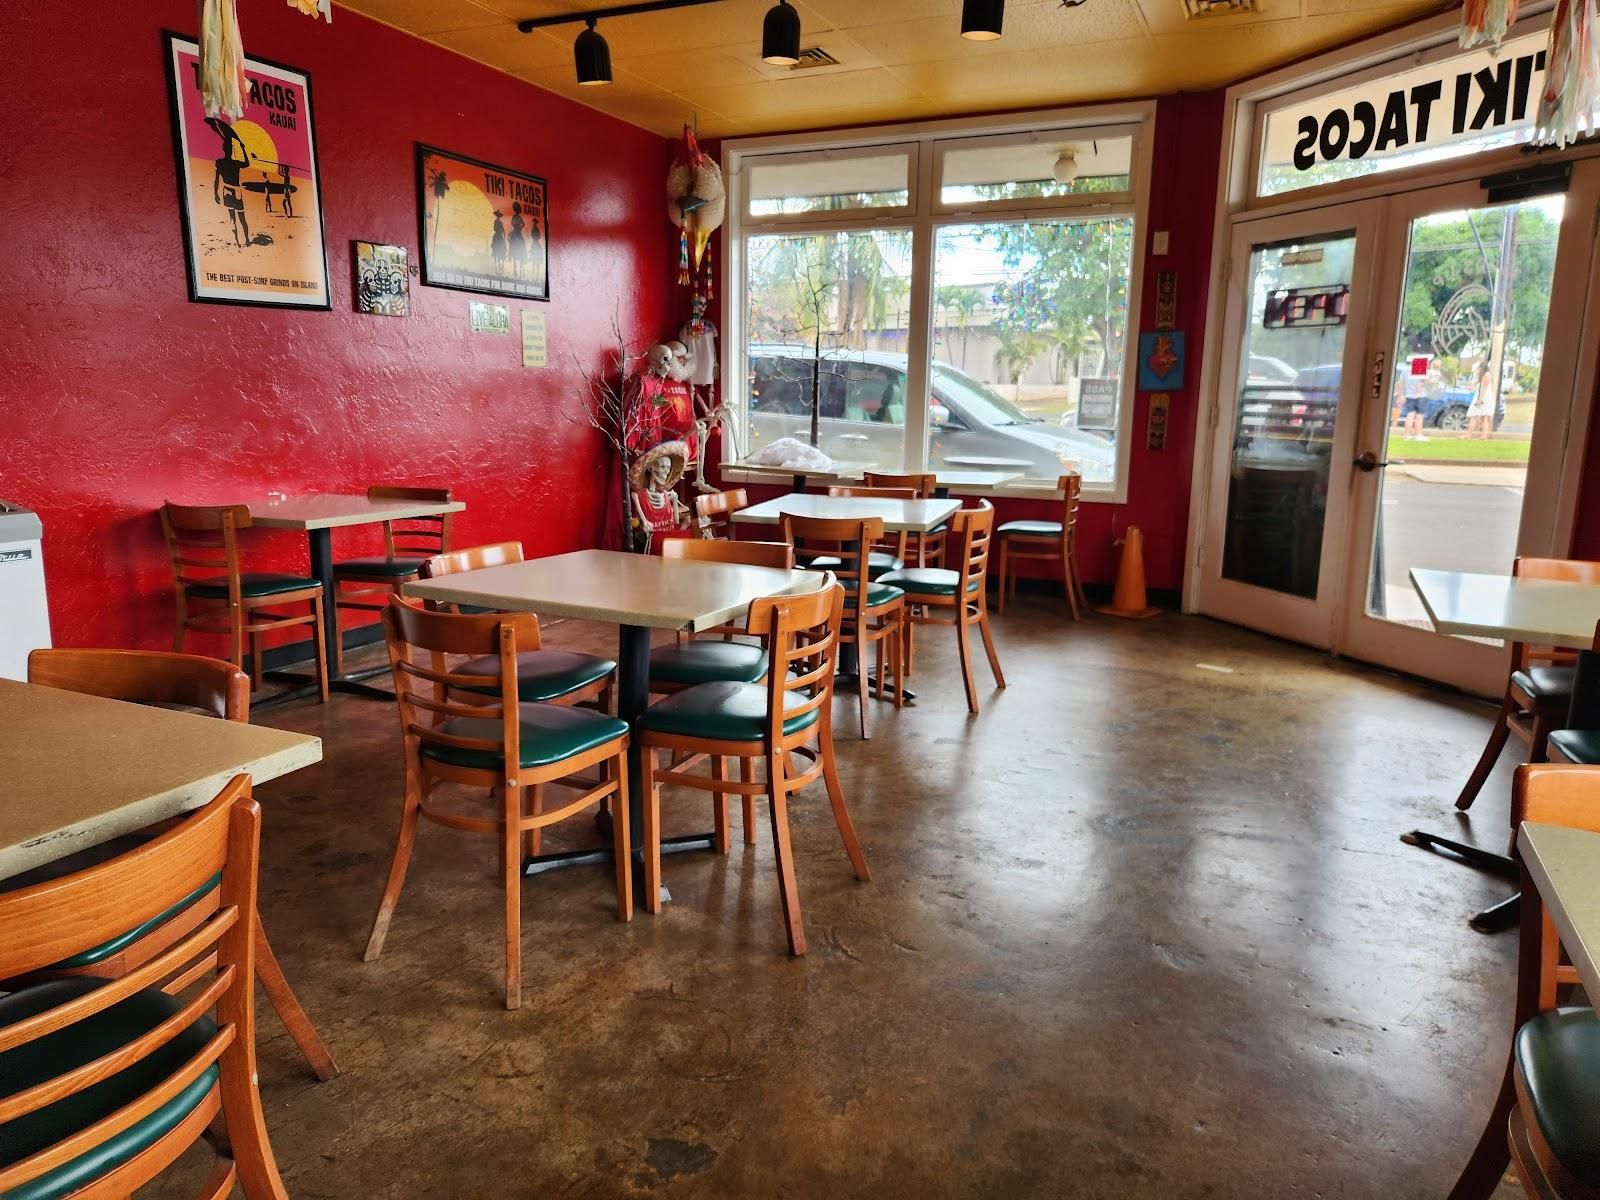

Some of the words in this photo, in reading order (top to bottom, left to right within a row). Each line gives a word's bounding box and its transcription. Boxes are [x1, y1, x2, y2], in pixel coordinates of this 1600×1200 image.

[249, 78, 297, 114] ACOS
[268, 111, 297, 131] KAUAI
[484, 173, 505, 197] TIKI
[508, 179, 541, 206] TACOS
[206, 272, 218, 282] THE
[220, 273, 234, 283] BEST
[237, 276, 268, 285] POST-SURF
[270, 278, 290, 288] GRINDS
[292, 279, 299, 288] ON
[300, 281, 319, 289] ISLAND
